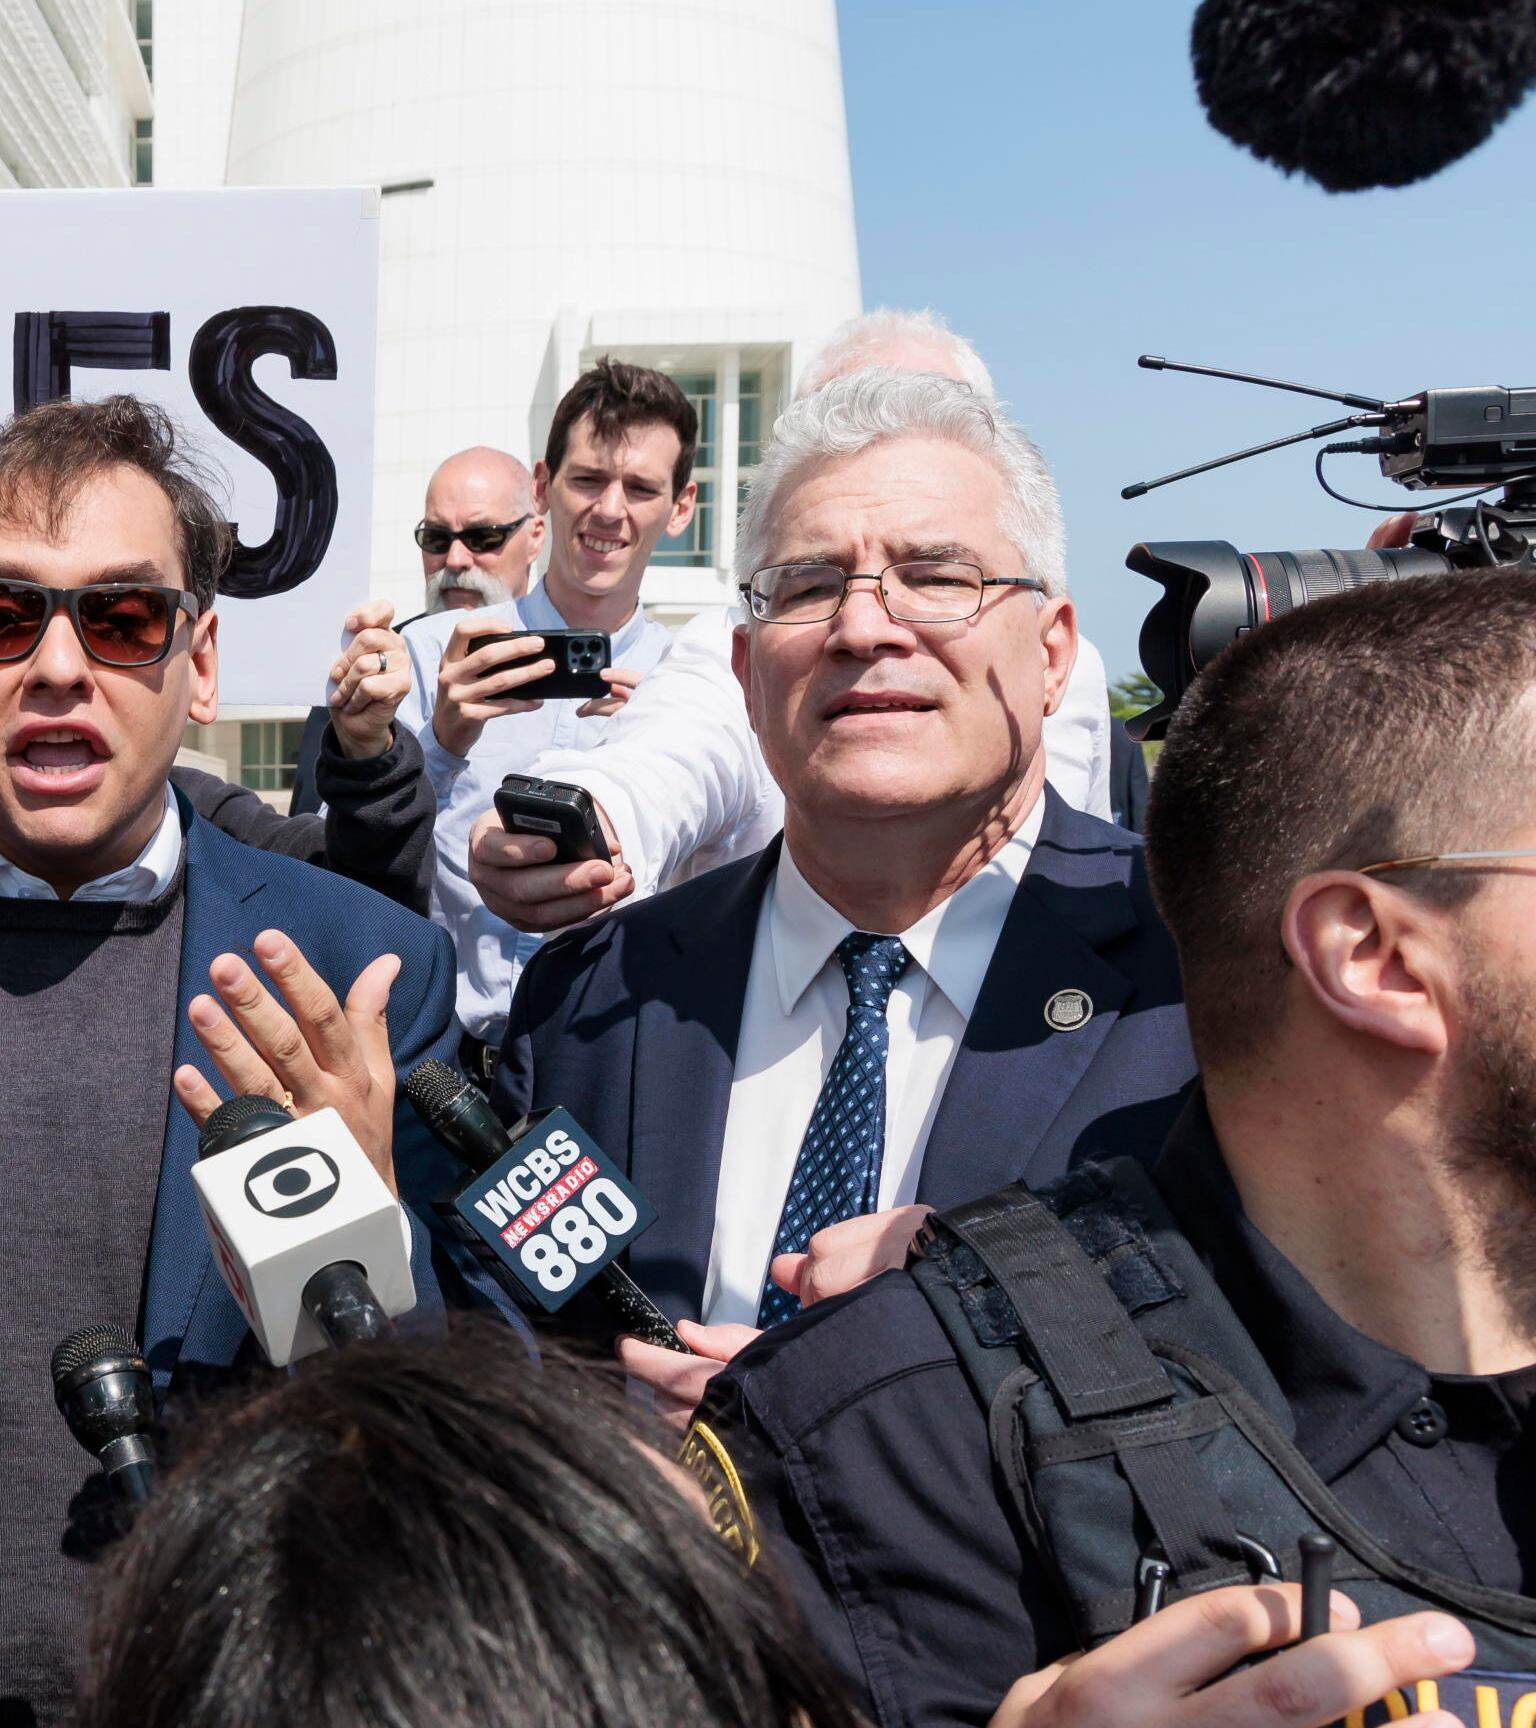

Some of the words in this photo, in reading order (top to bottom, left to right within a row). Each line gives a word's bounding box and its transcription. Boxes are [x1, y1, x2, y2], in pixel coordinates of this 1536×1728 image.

[474, 1129, 581, 1228] WCBS
[503, 1159, 597, 1247] NEWSRADIO
[520, 1178, 637, 1292] 880
